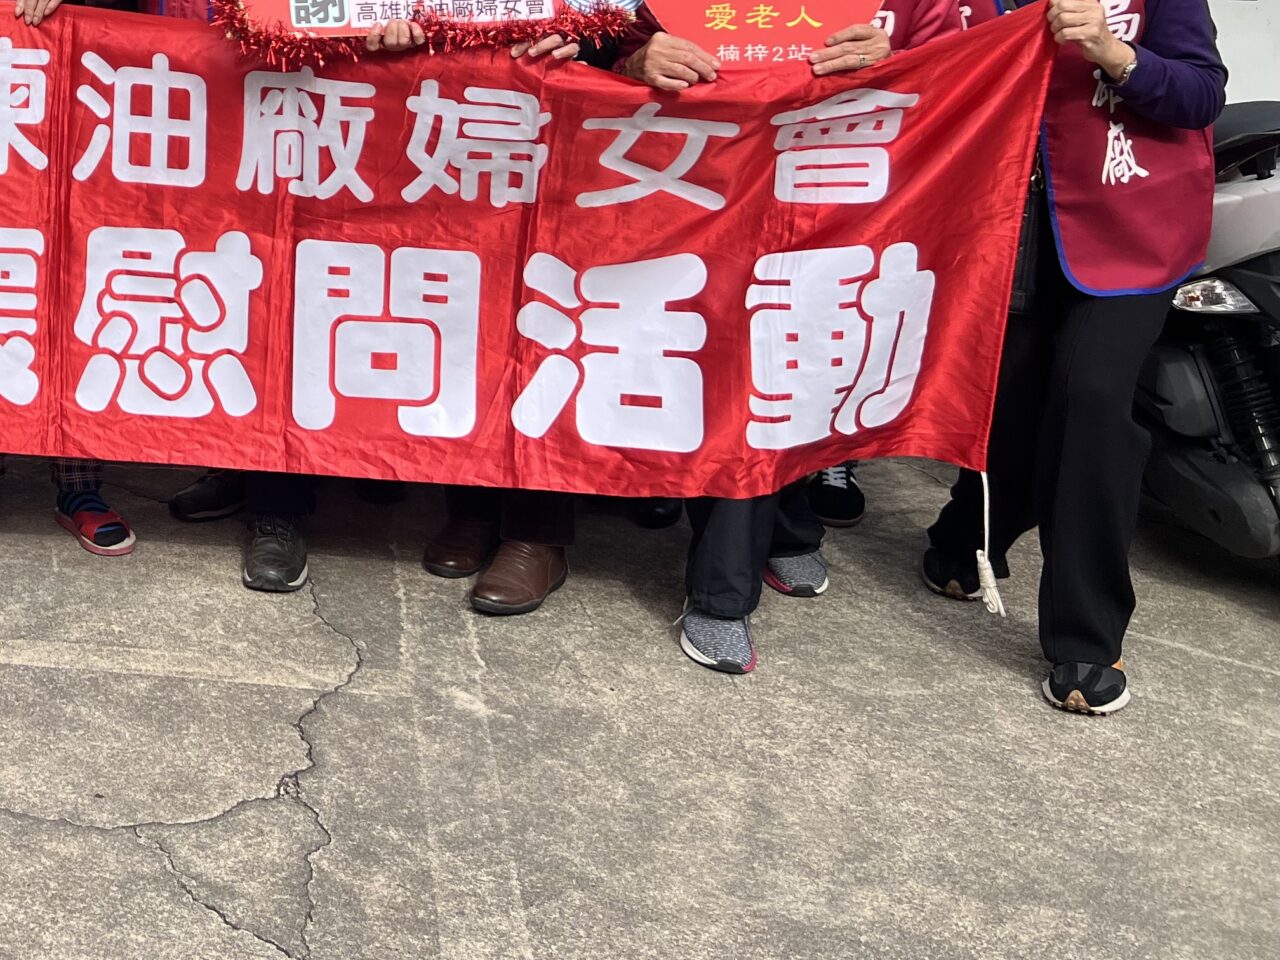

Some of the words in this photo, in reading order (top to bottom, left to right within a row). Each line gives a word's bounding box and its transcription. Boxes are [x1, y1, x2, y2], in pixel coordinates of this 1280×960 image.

[704, 2, 824, 31] 愛老人
[716, 43, 813, 63] 楠梓2站
